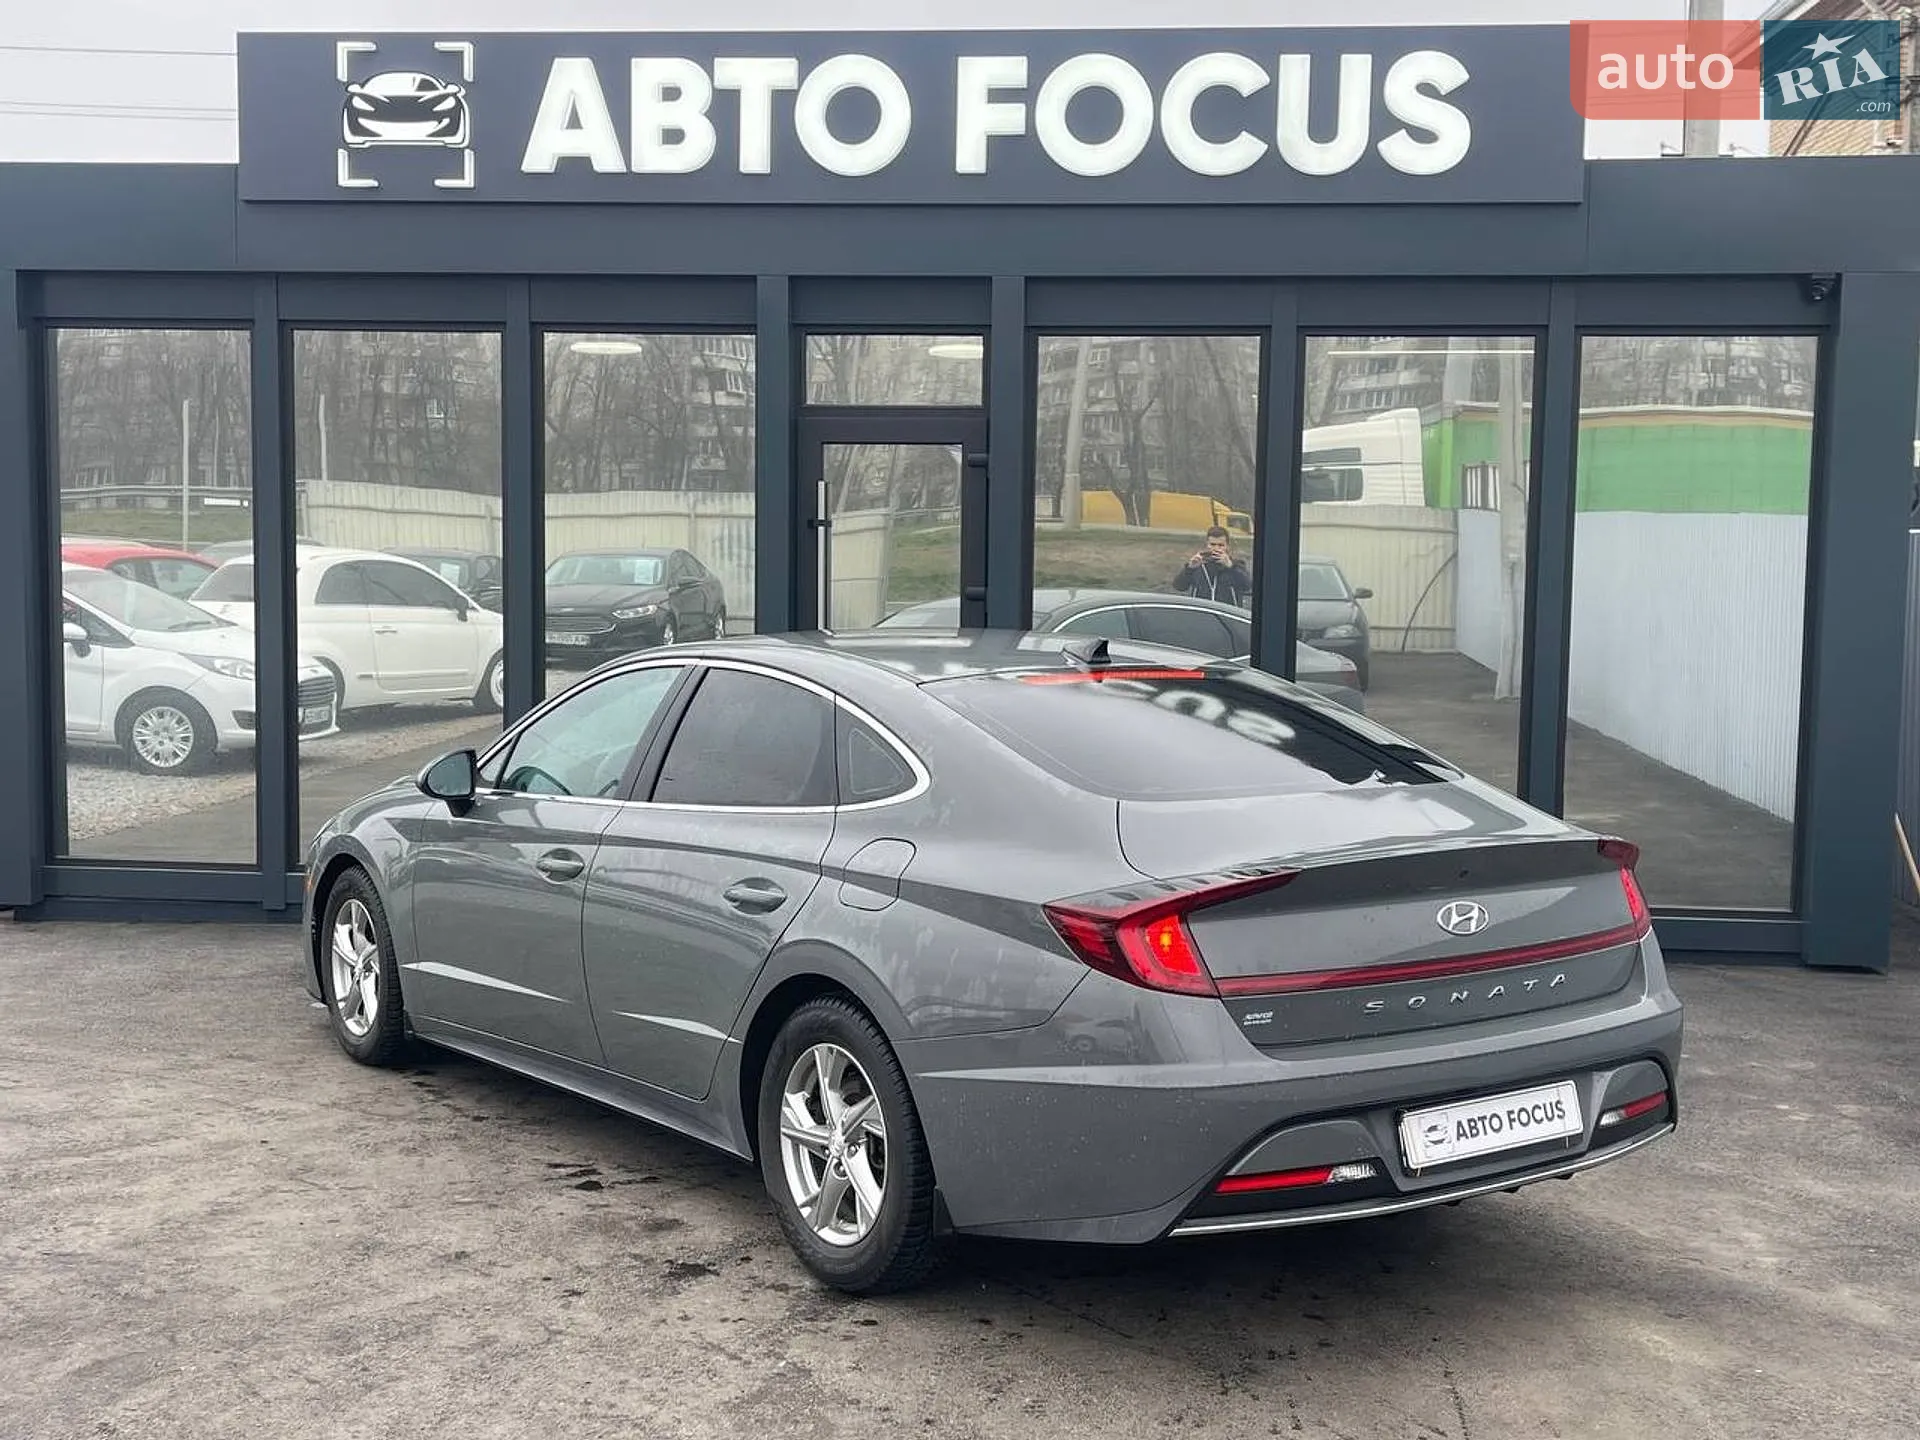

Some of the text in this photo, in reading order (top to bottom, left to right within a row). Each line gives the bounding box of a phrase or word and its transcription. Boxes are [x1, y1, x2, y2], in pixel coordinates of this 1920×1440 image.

[520, 50, 1472, 177] АВТО FOCUS
[1363, 973, 1566, 1014] SONATA
[1455, 1099, 1566, 1142] АВТО FOCUS
